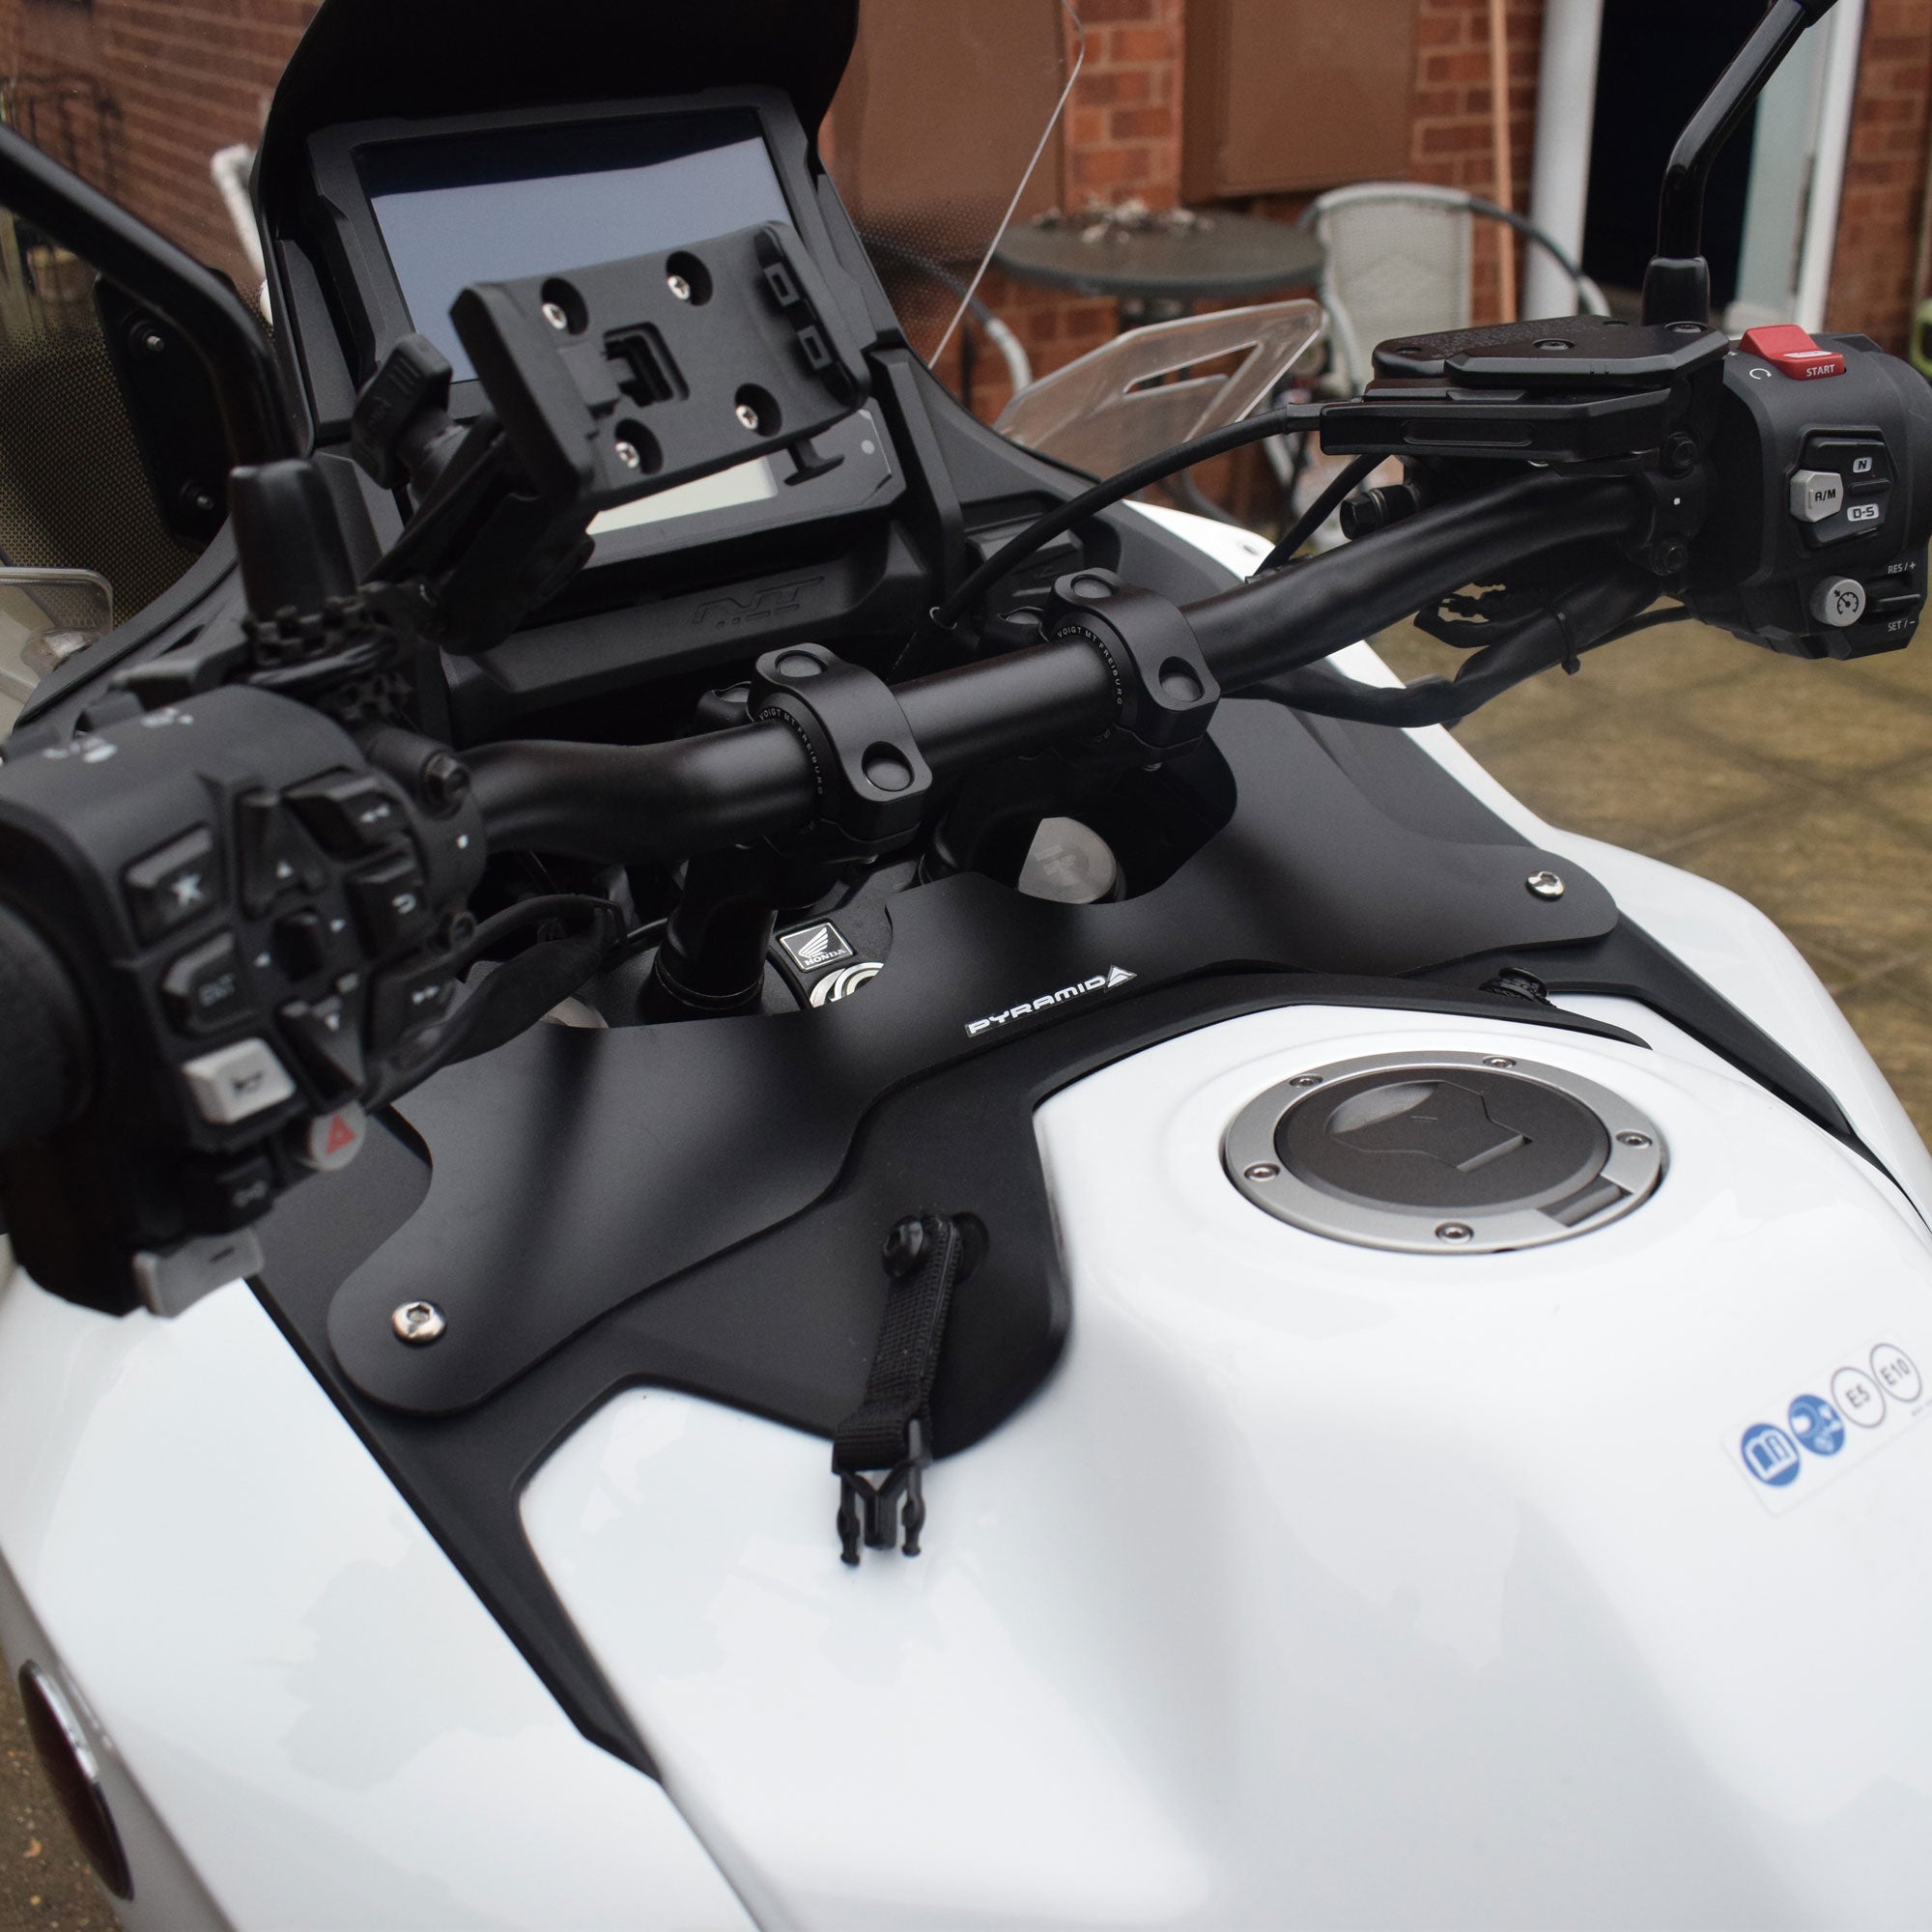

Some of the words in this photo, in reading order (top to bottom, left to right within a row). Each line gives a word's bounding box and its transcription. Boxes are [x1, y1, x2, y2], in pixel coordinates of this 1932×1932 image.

[1806, 364, 1834, 377] START
[1858, 460, 1867, 470] N
[1815, 488, 1835, 501] A/M
[1853, 506, 1874, 519] D-S
[1057, 626, 1082, 638] VOIGT
[1085, 630, 1097, 641] MT
[1098, 642, 1122, 705] FREIBURG
[758, 708, 781, 721] VOIGT
[783, 712, 796, 725] MT
[804, 949, 847, 966] HONDA
[968, 975, 1106, 1035] PYRAMID
[1881, 1357, 1910, 1385] E10
[1845, 1383, 1870, 1408] E5
